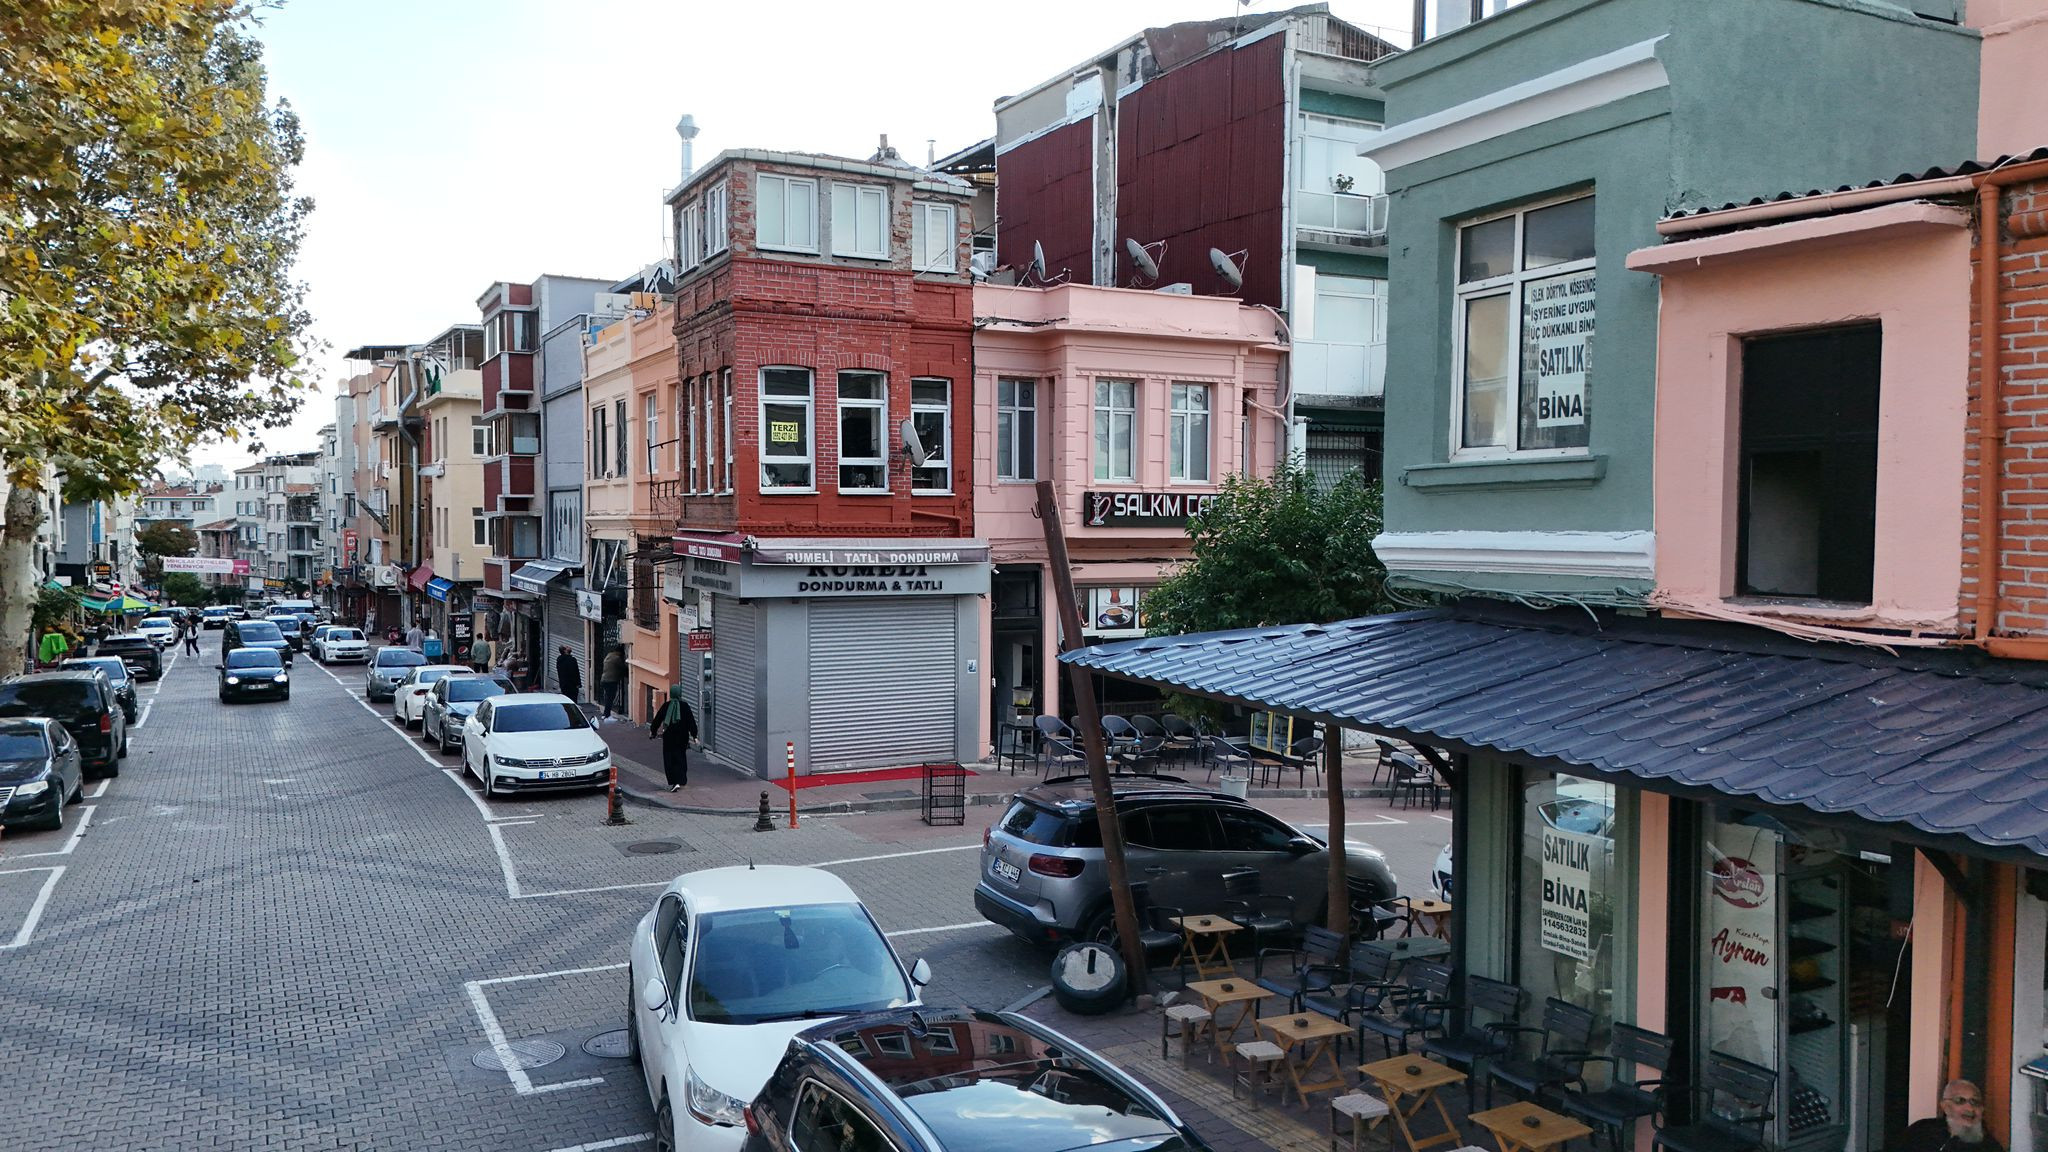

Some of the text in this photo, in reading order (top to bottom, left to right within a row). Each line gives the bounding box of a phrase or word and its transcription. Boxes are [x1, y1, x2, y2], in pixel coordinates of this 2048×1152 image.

[1546, 283, 1567, 300] DÖRTYOL
[1531, 299, 1596, 324] İŞYERİNE UYGUN
[1531, 317, 1595, 342] ÜÇ DÜKKANLI BİNA
[1540, 344, 1585, 377] SATILIK
[1538, 390, 1583, 420] BİNA
[1114, 493, 1181, 517] SALKIM
[785, 550, 959, 564] RUMELİ TATLI DONDURMA
[798, 580, 944, 593] DONDURMA & TATLI
[1544, 834, 1589, 872] SATILIK
[1543, 877, 1588, 913] BİNA
[1543, 917, 1587, 938] 1145632832
[1711, 927, 1769, 967] Ayran
